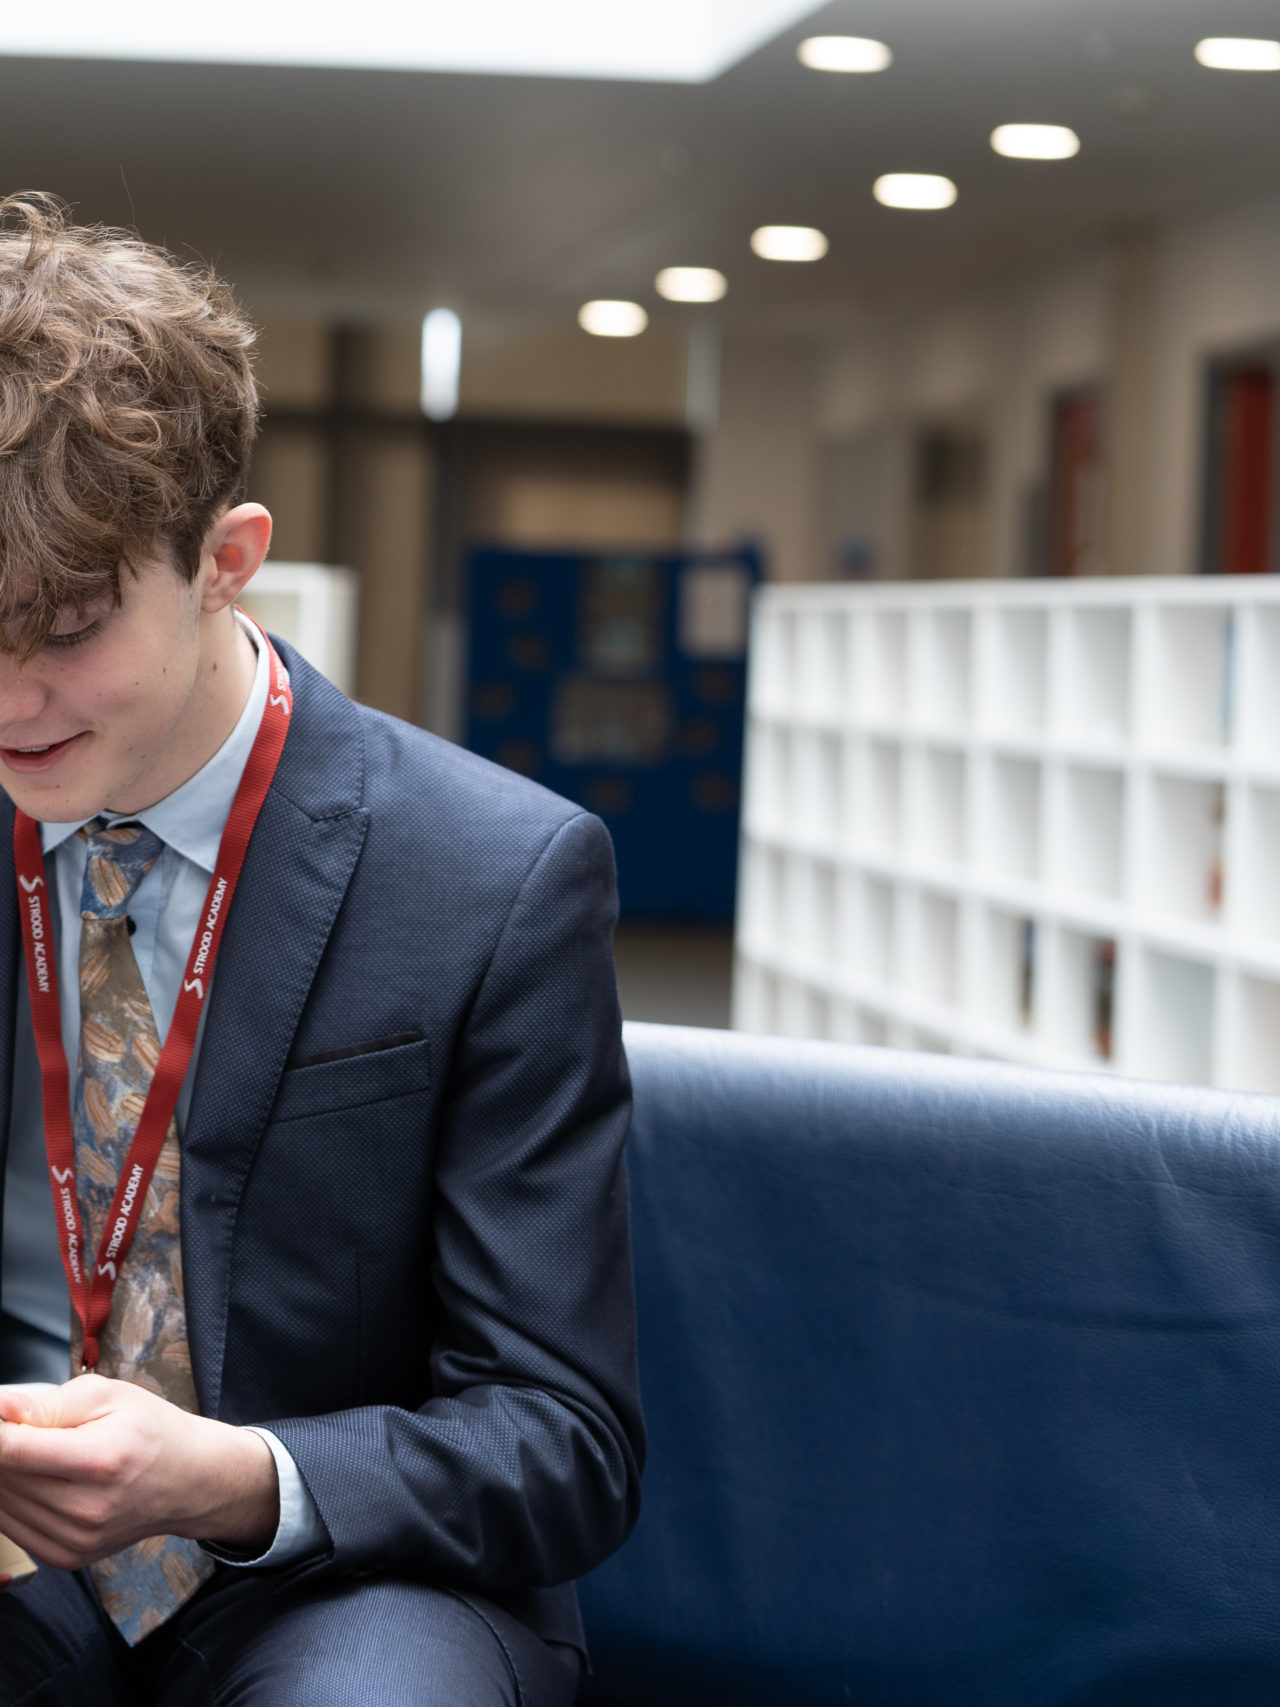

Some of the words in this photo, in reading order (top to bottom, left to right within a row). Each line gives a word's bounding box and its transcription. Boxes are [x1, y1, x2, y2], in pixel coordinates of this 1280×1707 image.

[28, 895, 45, 940] STROOD
[193, 930, 213, 975] STROOD
[206, 877, 228, 930] ACADEMY
[33, 941, 51, 993] ACADEMY
[60, 1187, 76, 1231] STROOD
[105, 1216, 128, 1258] STROOD
[120, 1163, 145, 1217] ACADEMY
[67, 1232, 82, 1284] ACADEMY
